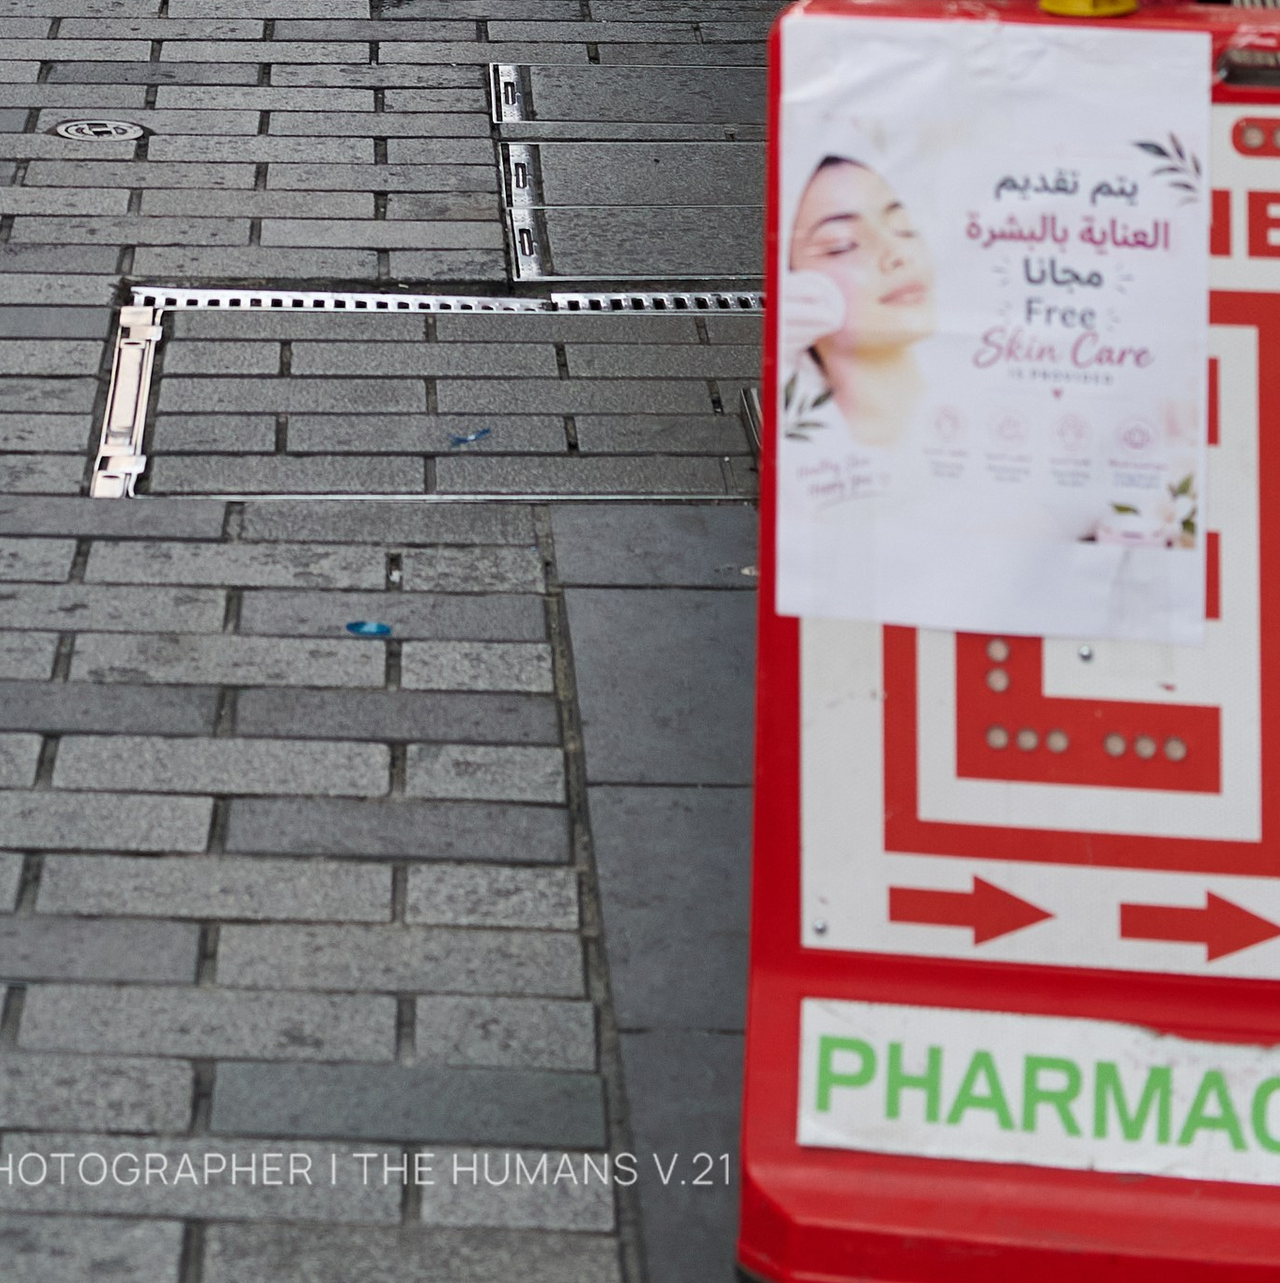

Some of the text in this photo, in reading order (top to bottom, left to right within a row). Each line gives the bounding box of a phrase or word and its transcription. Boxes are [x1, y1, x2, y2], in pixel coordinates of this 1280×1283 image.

[994, 169, 1139, 207] يتم تقديم
[966, 211, 1070, 254] بالبشرة
[1079, 215, 1171, 256] العناية
[1023, 256, 1105, 295] مجانا
[1024, 297, 1097, 330] Free
[973, 324, 1153, 370] Skin Care
